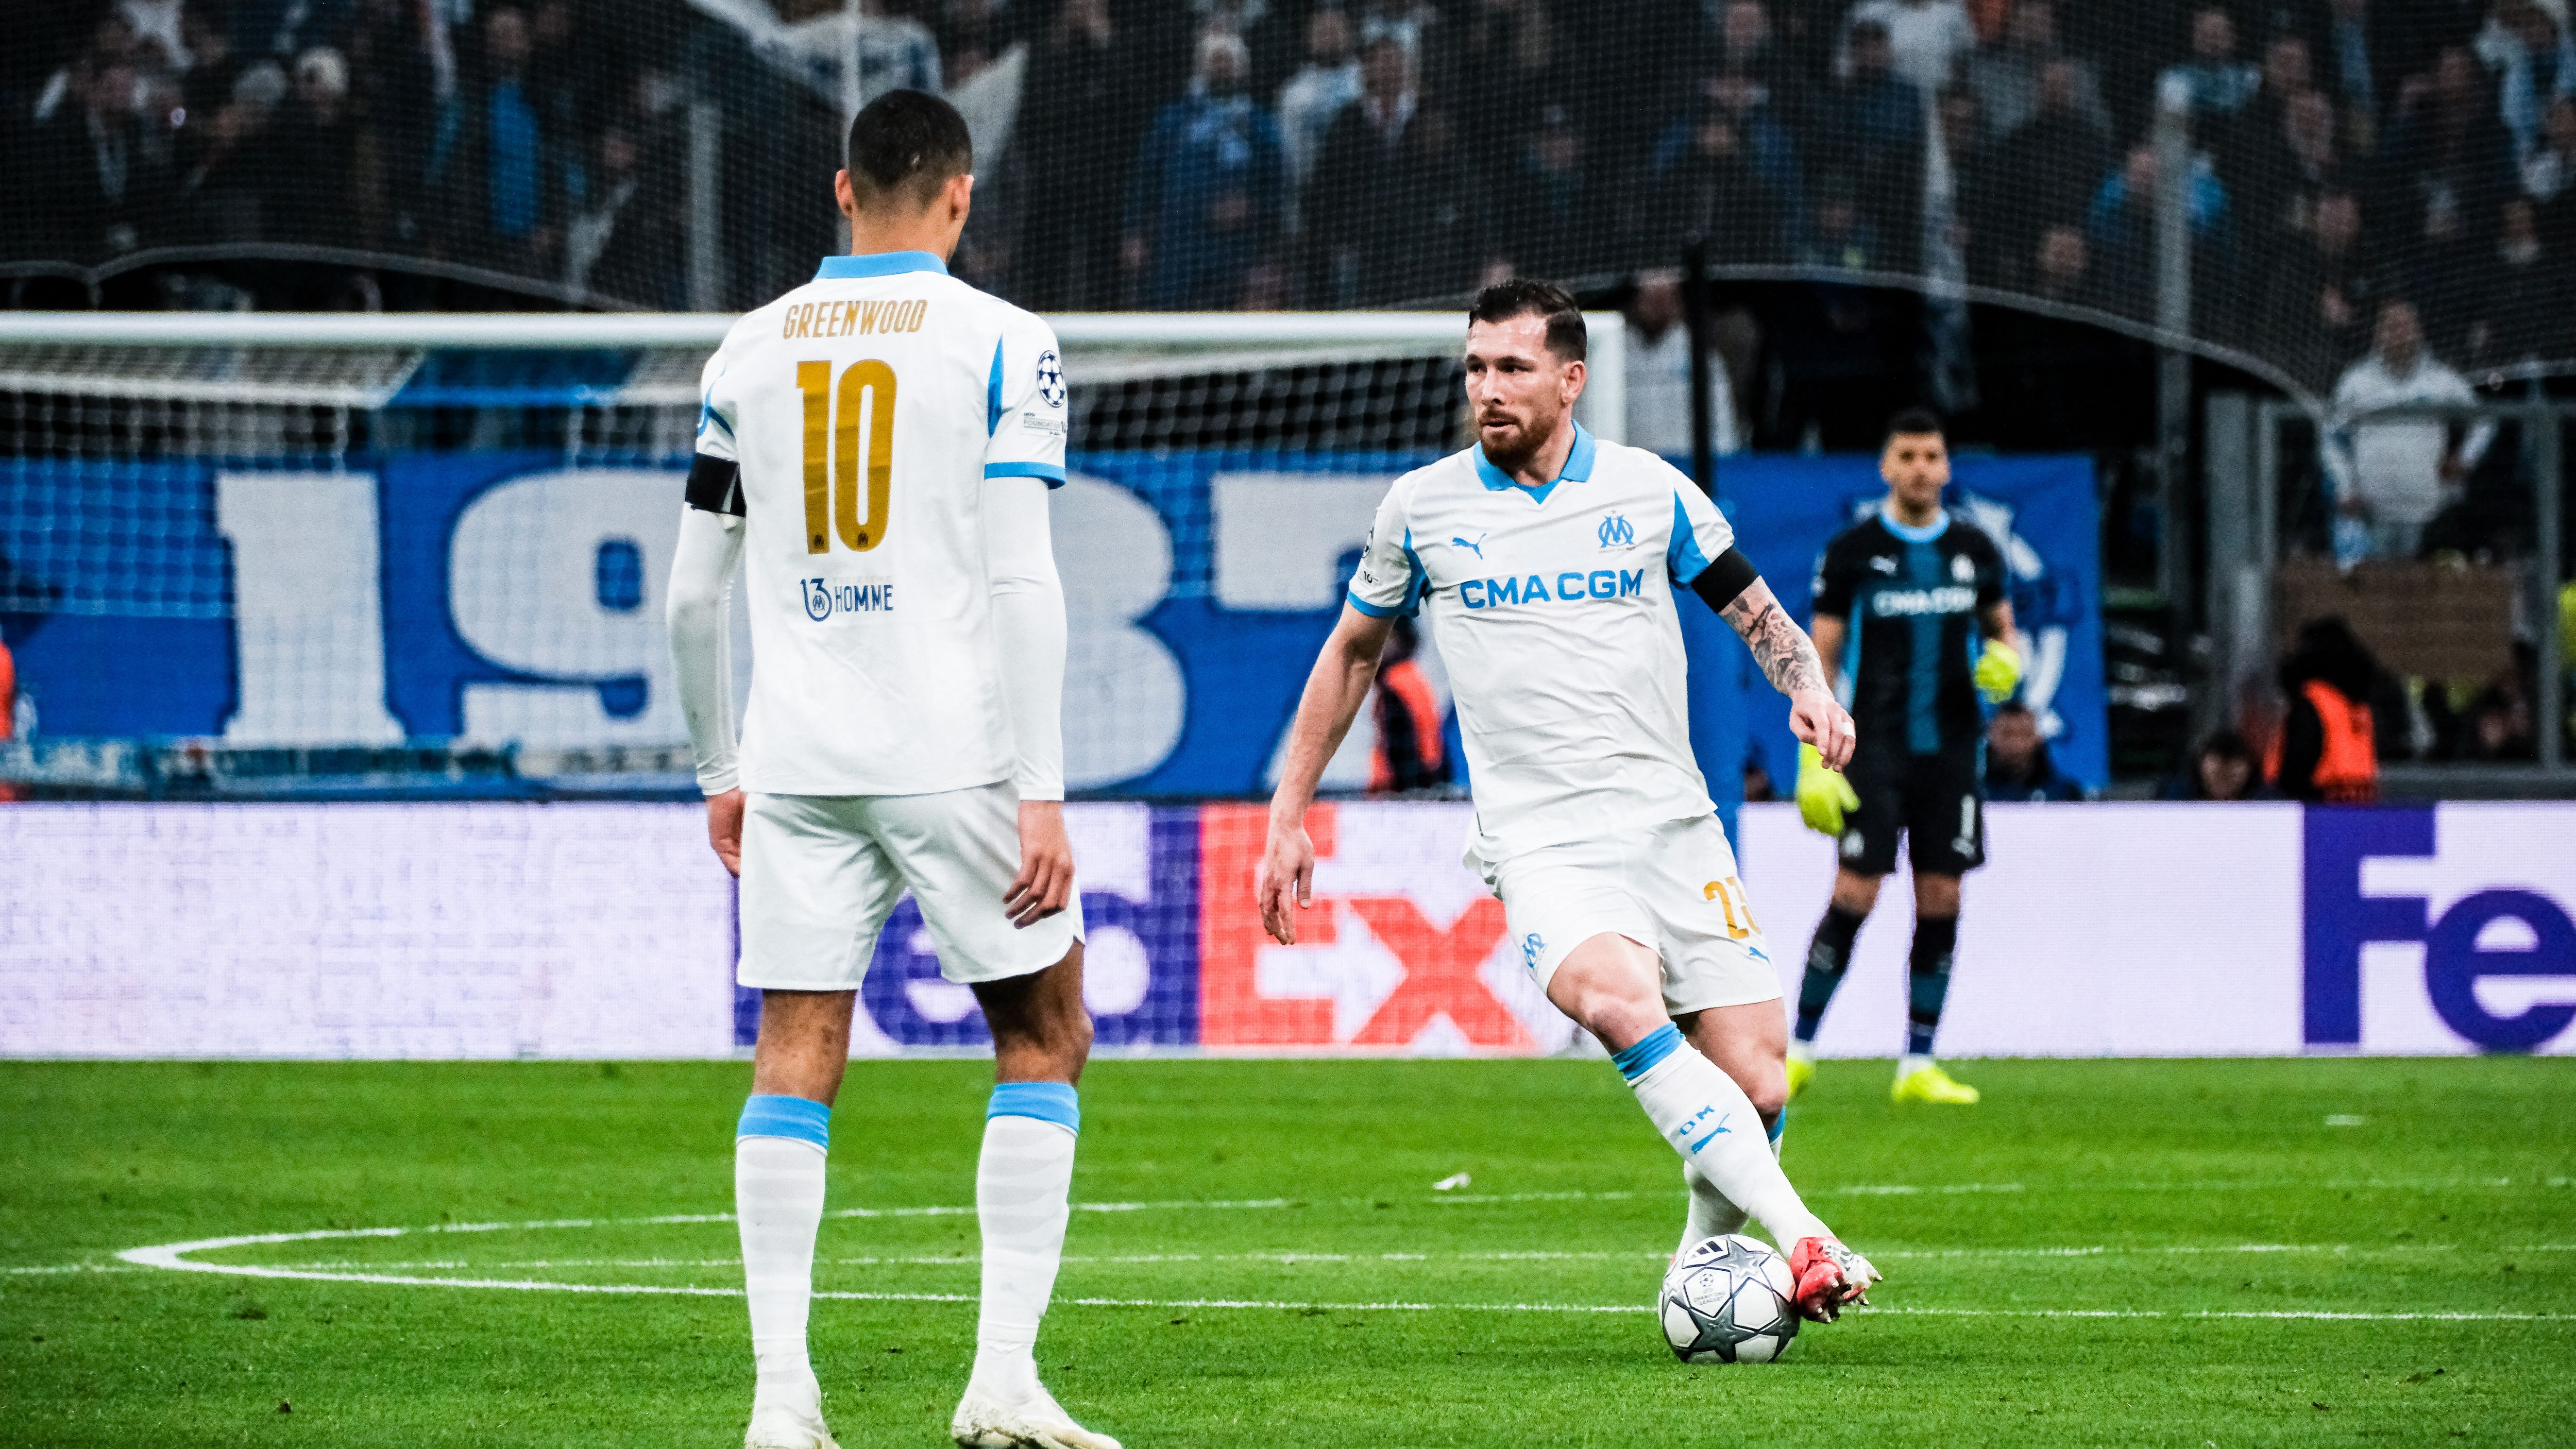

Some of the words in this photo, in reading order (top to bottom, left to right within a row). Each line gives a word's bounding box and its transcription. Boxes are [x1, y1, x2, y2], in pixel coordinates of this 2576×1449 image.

[783, 299, 927, 339] GREENWOOD
[796, 359, 897, 555] 10
[834, 584, 894, 612] HOMME
[1460, 575, 1551, 609] CMA
[1557, 568, 1644, 601] CGM
[733, 804, 1538, 1047] edEx
[1680, 1105, 1715, 1135] OM
